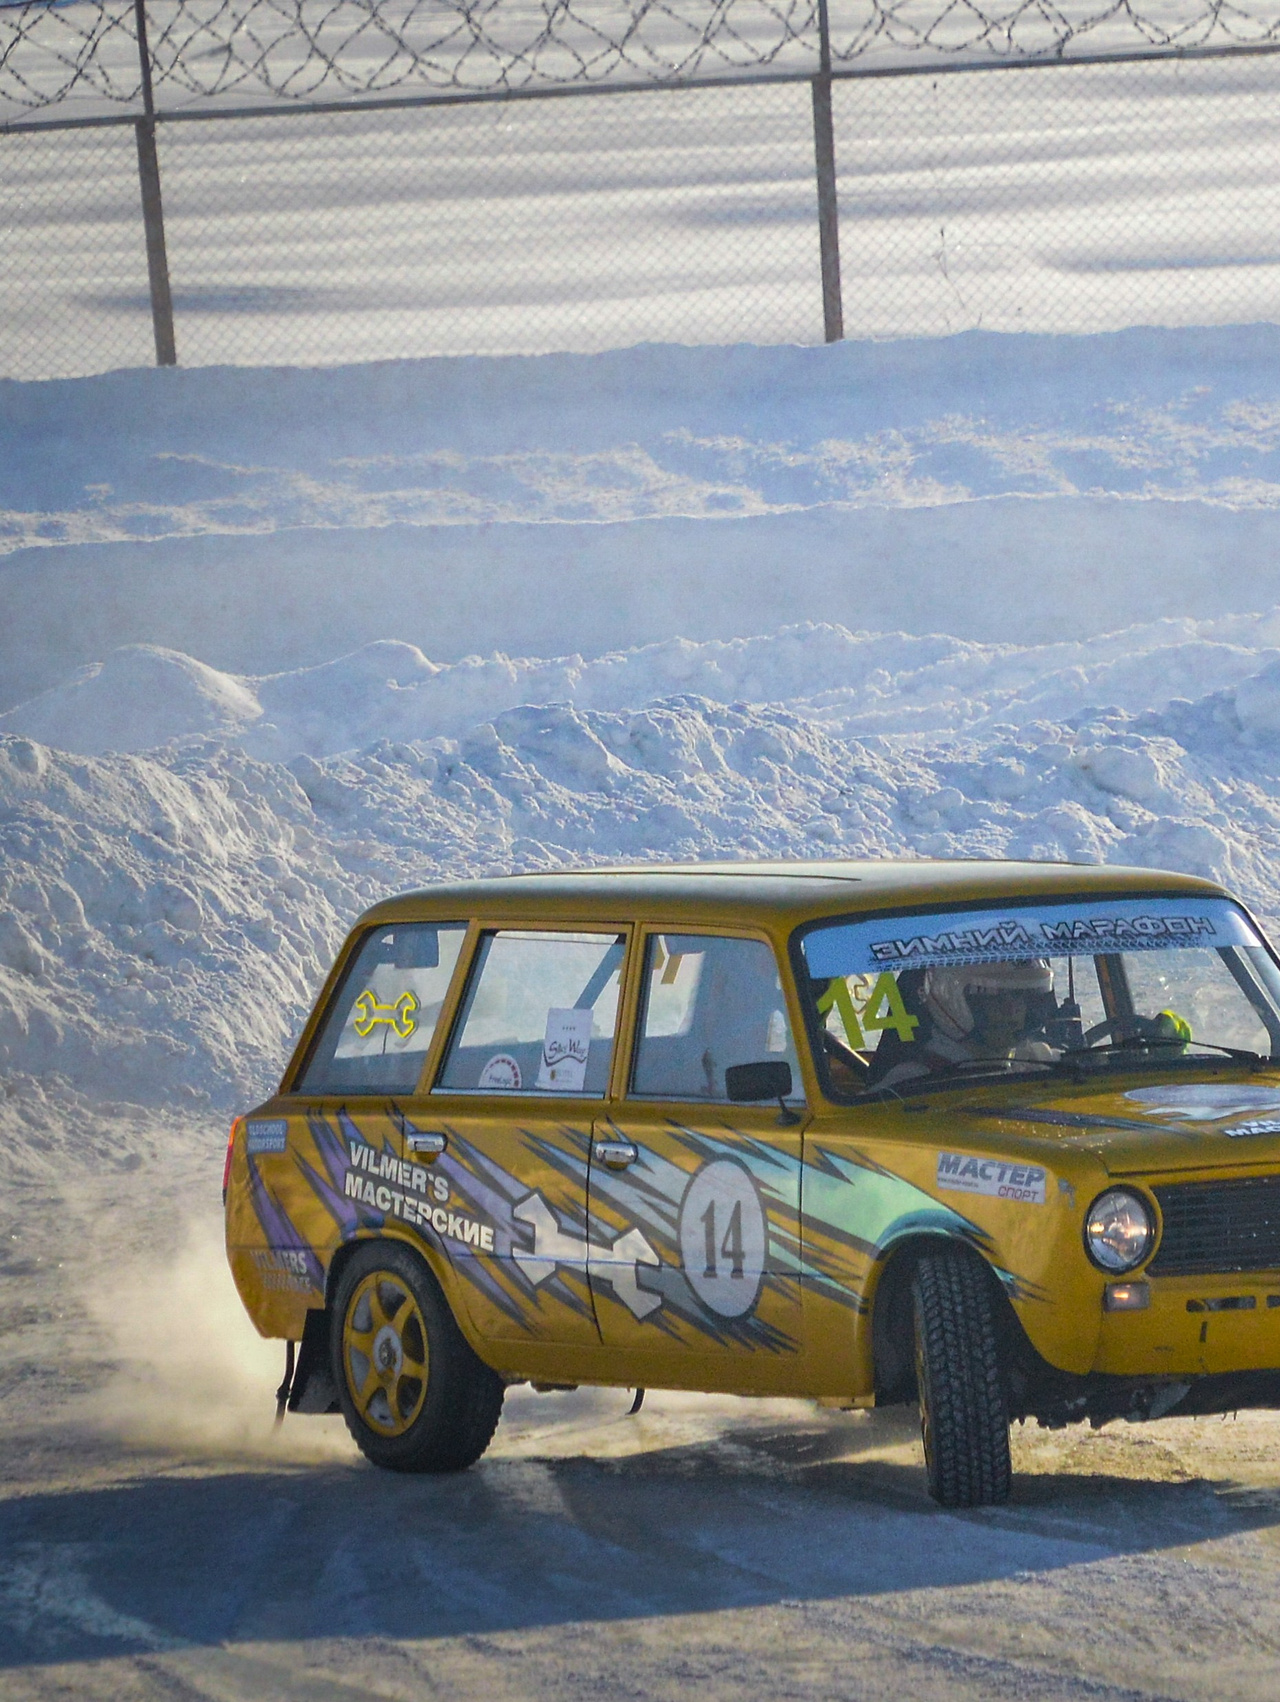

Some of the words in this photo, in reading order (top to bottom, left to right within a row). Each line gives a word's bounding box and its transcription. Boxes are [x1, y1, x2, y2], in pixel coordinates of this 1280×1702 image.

[869, 920, 1030, 961] ЗИМНИЙ
[1040, 915, 1217, 941] МАРАФОН
[816, 971, 920, 1051] 14
[937, 1153, 1046, 1188] МАСТЕР
[998, 1185, 1039, 1202] СПОРТ
[344, 1172, 495, 1252] МАСТЕРСКИЕ
[700, 1199, 746, 1280] 14
